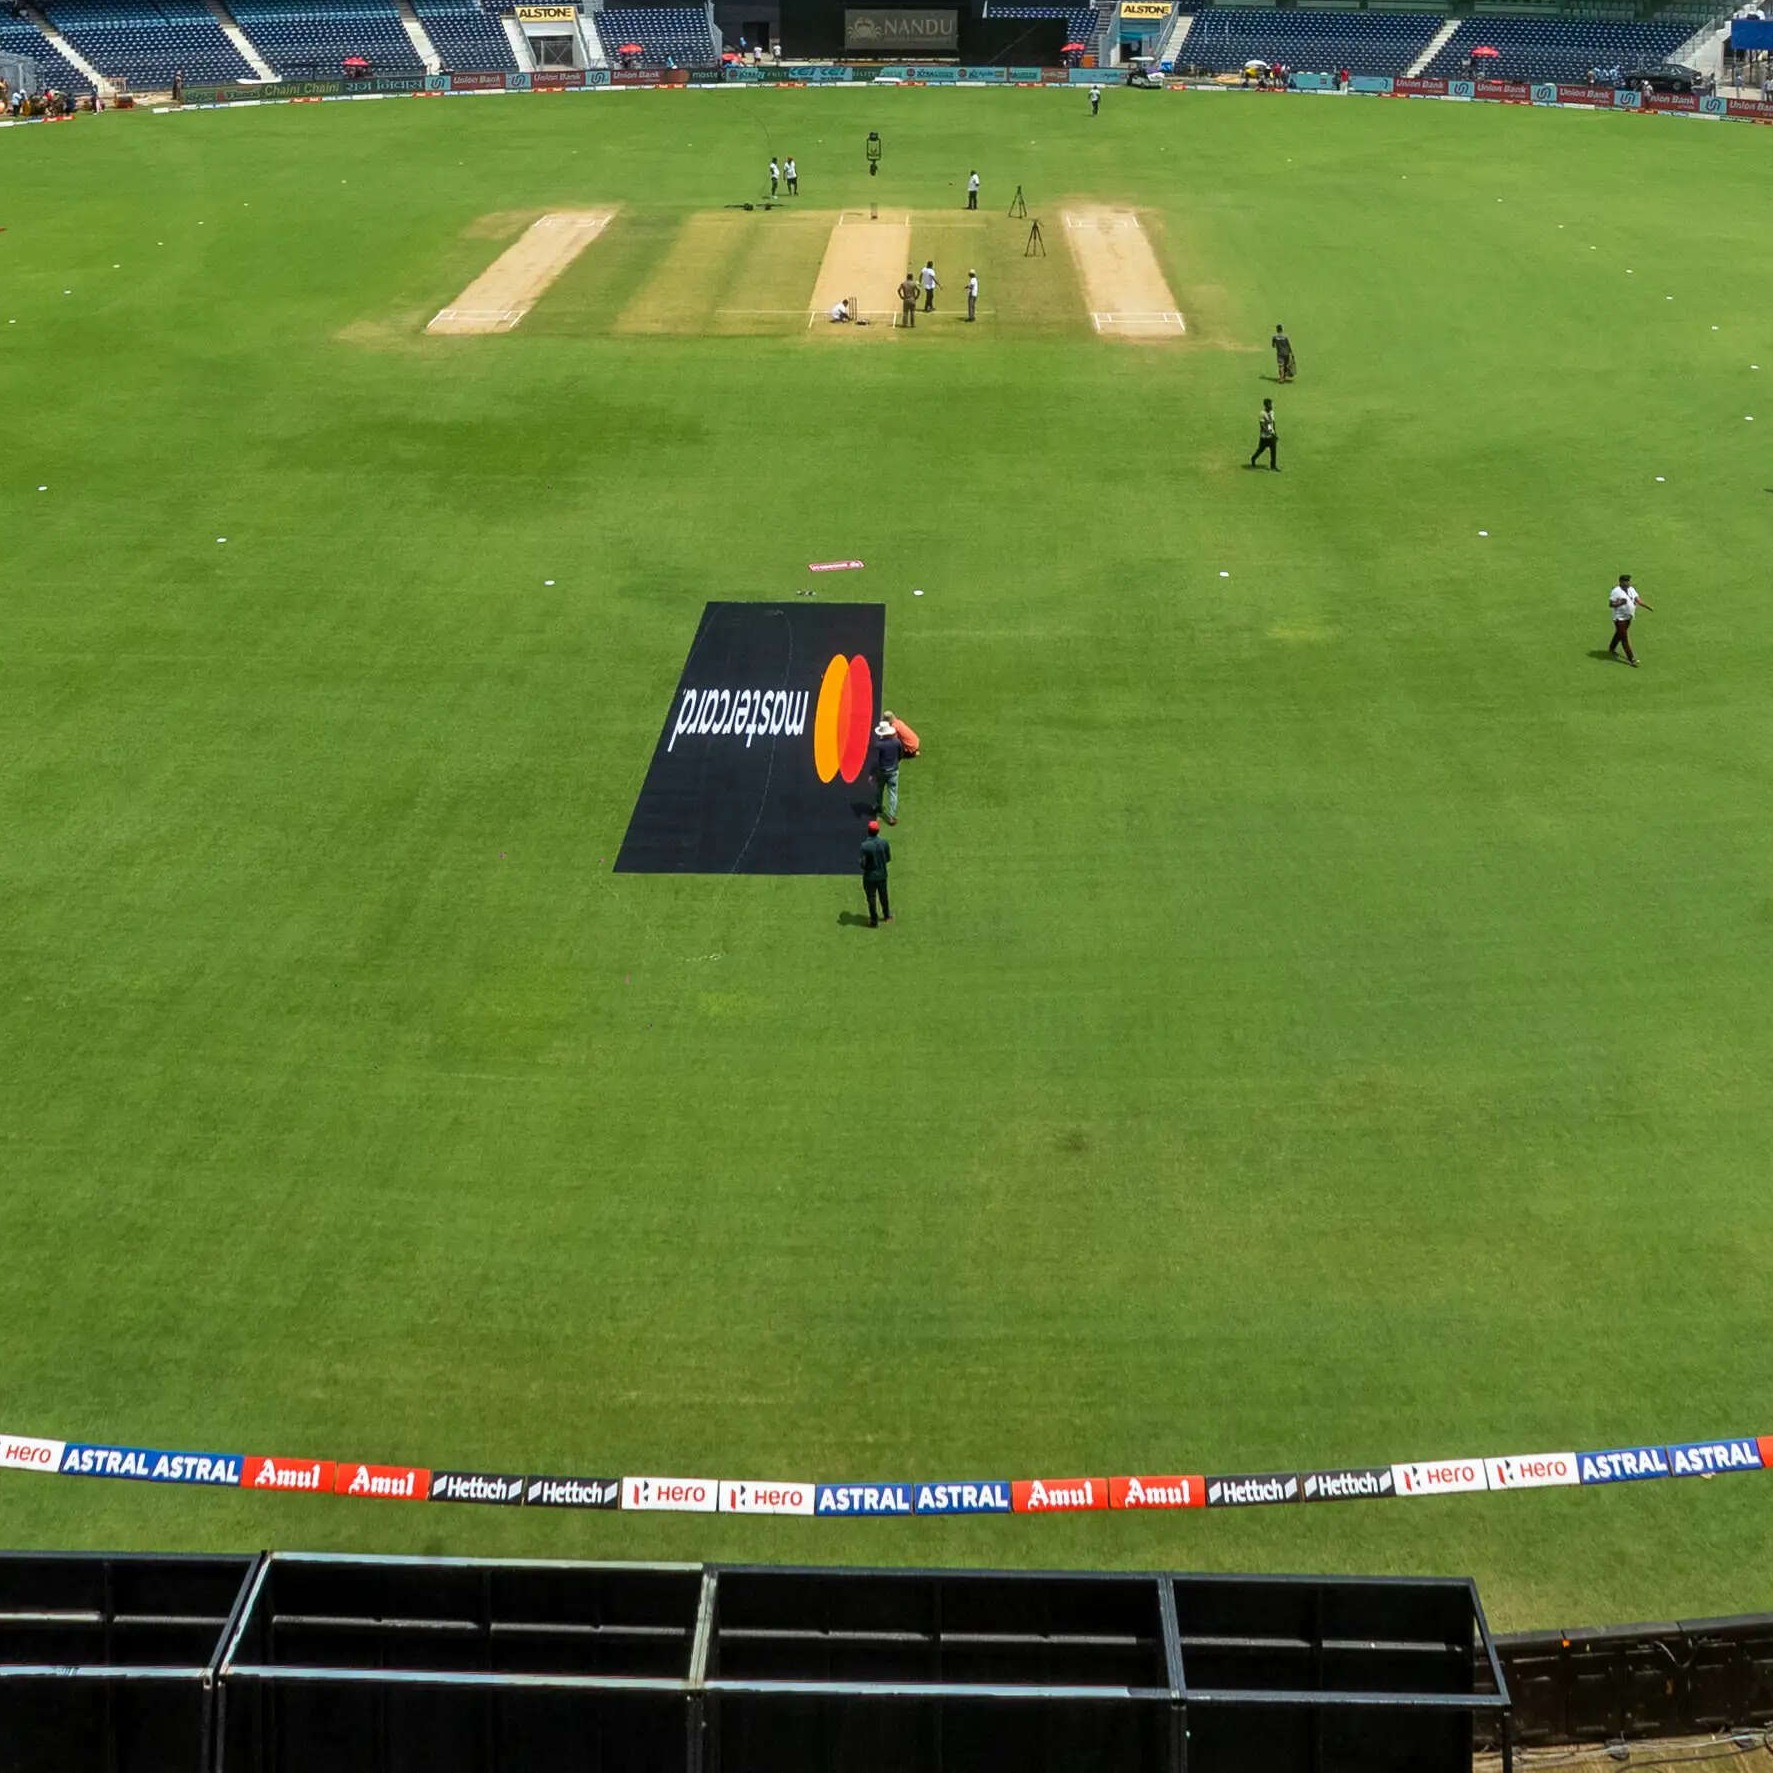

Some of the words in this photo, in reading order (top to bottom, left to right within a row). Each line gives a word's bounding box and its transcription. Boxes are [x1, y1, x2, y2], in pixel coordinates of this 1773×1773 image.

[519, 8, 571, 20] ALSTONE
[1123, 4, 1171, 16] ALSTONE
[884, 18, 953, 36] NANDU
[668, 688, 809, 752] mastercard
[6, 1445, 52, 1464] Hero
[63, 1448, 150, 1477] ASTRAL
[1582, 1450, 1668, 1481] ASTRAL
[1674, 1443, 1761, 1473] ASTRAL
[151, 1455, 240, 1484] ASTRAL
[254, 1459, 321, 1489] Amul
[348, 1464, 415, 1496] Amul
[1427, 1463, 1475, 1484] Hero
[1520, 1457, 1567, 1479] Hero
[447, 1476, 508, 1500] Hettich
[542, 1480, 604, 1505] Hettich
[657, 1484, 706, 1504] Hero
[917, 1484, 1009, 1510] ASTRAL
[1027, 1479, 1094, 1509] Amul
[1125, 1475, 1192, 1507] Amul
[1223, 1478, 1285, 1505] Hettich
[1317, 1472, 1379, 1497] Hettich
[754, 1488, 803, 1507] Hero
[819, 1487, 911, 1512] ASTRAL
